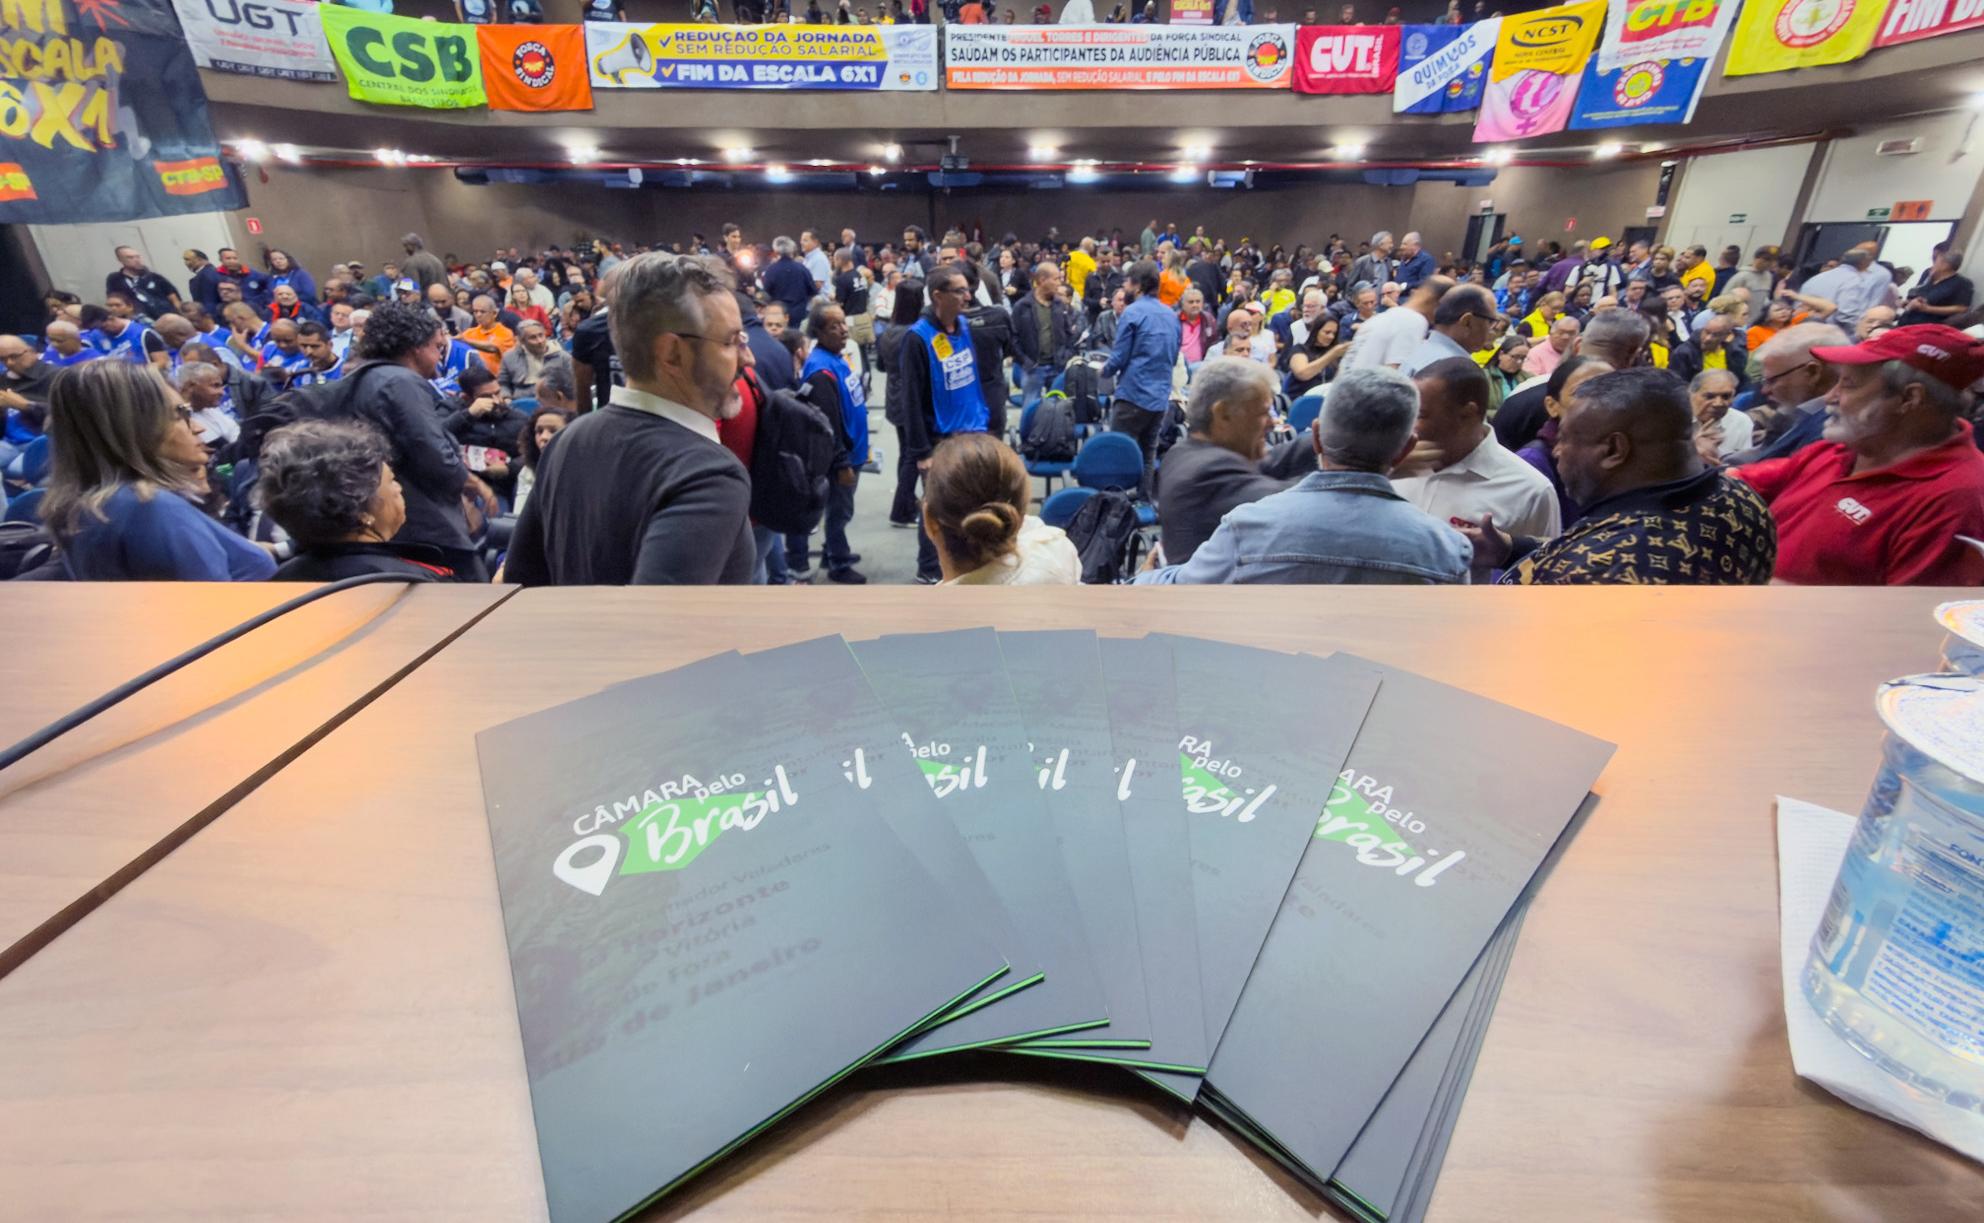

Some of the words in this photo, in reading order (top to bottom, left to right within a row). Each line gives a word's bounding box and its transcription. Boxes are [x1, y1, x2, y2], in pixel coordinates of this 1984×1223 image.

[205, 0, 304, 37] UGT
[764, 31, 787, 43] DA
[794, 32, 876, 44] JORNADA
[1151, 33, 1162, 41] DA
[1166, 33, 1197, 43] FORÇA
[1200, 32, 1242, 42] SINDICAL
[1524, 24, 1569, 39] NCST
[346, 26, 473, 83] CSB
[676, 43, 709, 55] SEM
[714, 41, 792, 56] REDUÇÃO
[799, 44, 876, 56] SALARIAL
[951, 44, 998, 62] SAÚDAM
[1002, 48, 1017, 61] OS
[1020, 48, 1106, 61] PARTICIPANTES
[1111, 48, 1125, 61] DA
[1129, 44, 1189, 62] AUDIÊNCIA
[1194, 44, 1241, 61] PÚBLICA
[1310, 34, 1376, 73] CUT
[676, 64, 714, 81] FIM
[718, 64, 749, 82] DA
[753, 65, 837, 82] ESCALA
[841, 66, 877, 82] 6X1
[1057, 71, 1071, 83] SEM
[1073, 69, 1107, 84] REDUÇÃO
[161, 165, 224, 186] CTB-SP
[1917, 344, 1949, 361] CUT
[1190, 756, 1242, 778] pelo
[573, 774, 703, 836] CÂMARA
[694, 773, 746, 804] pelo
[637, 765, 799, 864] Brasil
[1365, 801, 1426, 834] pelo
